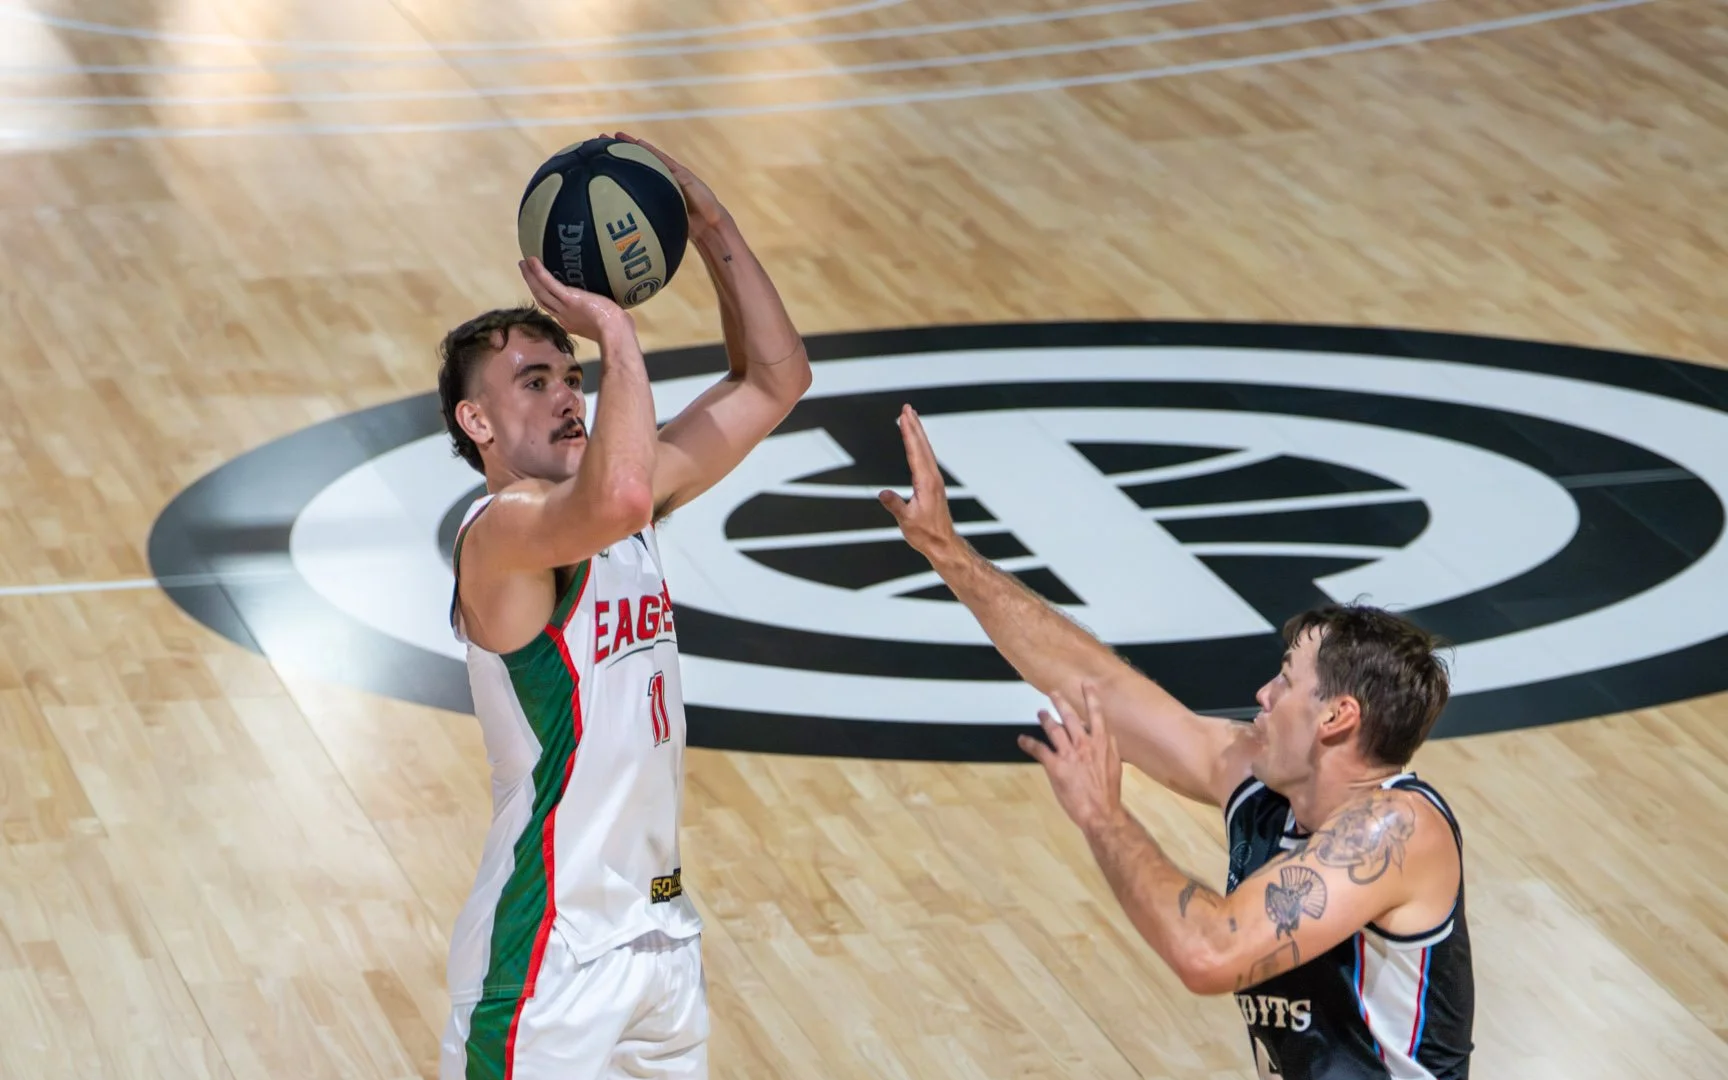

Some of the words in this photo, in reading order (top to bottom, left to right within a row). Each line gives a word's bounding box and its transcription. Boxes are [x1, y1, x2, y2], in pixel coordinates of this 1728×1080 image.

[557, 221, 588, 291] DING
[606, 212, 651, 280] ONE
[1235, 994, 1312, 1032] DITS
